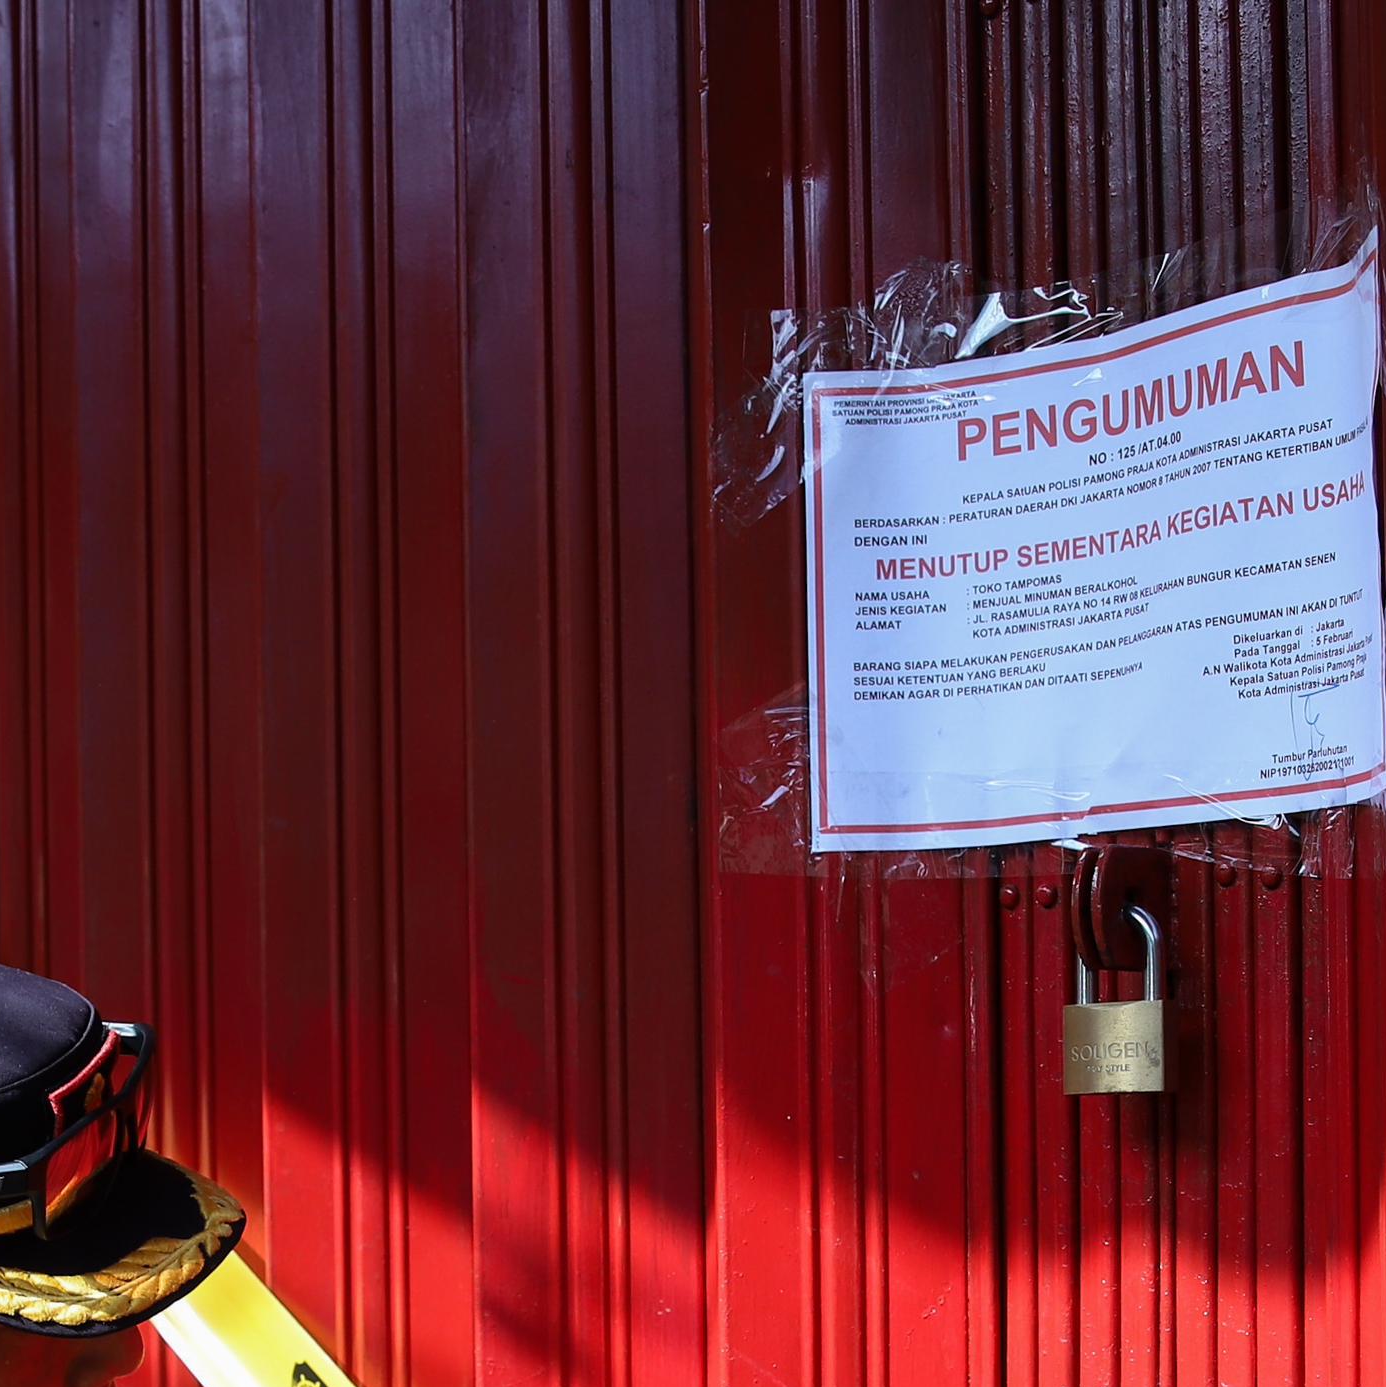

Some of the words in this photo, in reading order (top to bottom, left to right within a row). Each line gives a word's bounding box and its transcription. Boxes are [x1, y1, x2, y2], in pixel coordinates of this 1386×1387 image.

[832, 409, 865, 417] SATUAN
[866, 408, 893, 416] POLISI
[894, 406, 929, 415] PAMONG
[931, 404, 956, 413] PRAJA
[958, 400, 979, 409] KOTA
[833, 400, 886, 408] PEMERINTAH
[887, 398, 925, 407] PROVINSI
[957, 340, 1305, 461] PENGUMUMAN
[844, 417, 902, 426] ADMINISTRASI
[903, 415, 940, 425] JAKARTA
[941, 410, 967, 421] PUSAT
[963, 487, 1004, 504] KEPALA
[1048, 478, 1081, 491] POLISI
[1083, 469, 1125, 486] PAMONG
[1127, 461, 1154, 477] PRAJA
[1155, 453, 1177, 468] KOTA
[1178, 435, 1241, 462] ADMINISTRASI
[1244, 427, 1296, 445] JAKARTA
[1299, 418, 1333, 435] PUSAT
[1089, 452, 1107, 466] NO
[1118, 446, 1136, 460] 125
[1138, 431, 1182, 455] /AT.04.00
[854, 516, 939, 529] BERDASARKAN
[949, 508, 1013, 524] PERATURAN
[1015, 498, 1058, 515] DAERAH
[1061, 496, 1078, 508] DKI
[1080, 487, 1125, 504] JAKARTA
[1126, 478, 1157, 494] NOMOR
[1158, 475, 1163, 486] 8
[1165, 467, 1191, 483] TAHUN
[1192, 461, 1211, 475] 2007
[1214, 451, 1263, 469] TENTANG
[1266, 438, 1333, 460] KETERTIBAN
[1335, 429, 1356, 446] UMUM
[854, 536, 908, 547] DENGAN
[911, 535, 928, 546] INI
[876, 549, 1009, 581] MENUTUP
[1017, 520, 1161, 568] SEMENTARA
[1167, 491, 1294, 538] KEGIATAN
[1303, 470, 1365, 512] USAHA
[855, 592, 888, 601] NAMA
[890, 590, 930, 601] USAHA
[973, 582, 1002, 595] TOKO
[1005, 574, 1062, 590] TAMPOMAS
[855, 620, 902, 631] ALAMAT
[973, 613, 988, 624] JL.
[991, 606, 1050, 622] RASAMULIA
[1053, 601, 1080, 613] RAYA
[1083, 598, 1098, 609] NO
[1101, 596, 1111, 607] 14
[1113, 593, 1128, 605] RW
[1139, 577, 1185, 599] KELURAHAN
[1186, 569, 1232, 586] BUNGUR
[1234, 558, 1303, 579] KECAMATAN
[1304, 551, 1336, 568] SENEN
[855, 606, 887, 616] JENIS
[890, 603, 947, 615] KEGIATAN
[973, 595, 1022, 609] MENJUAL
[1024, 588, 1071, 603] MINUMAN
[1074, 575, 1138, 595] BERALKOHOL
[853, 661, 901, 672] BARANG
[904, 659, 938, 670] SIAPA
[940, 652, 1008, 668] MELAKUKAN
[1010, 642, 1093, 662] PENGERUSAKAN
[1095, 639, 1116, 651] DAN
[1118, 624, 1173, 647] PELANGGARAN
[1175, 618, 1202, 632] ATAS
[1205, 608, 1284, 628] PENGUMUMAN
[1286, 605, 1299, 617] INI
[1301, 599, 1327, 615] AKAN
[1329, 597, 1338, 609] DI
[973, 628, 1002, 639] KOTA
[1004, 616, 1076, 635] ADMINISTRASI
[1078, 608, 1123, 625] JAKARTA
[1124, 602, 1150, 618] PUSAT
[1233, 628, 1292, 645] Dikeluarkan
[1294, 625, 1303, 636] di
[1315, 618, 1345, 633] Jakarta
[1234, 646, 1260, 659] Pada
[1263, 640, 1301, 656] Tanggal
[1316, 636, 1321, 647] 5
[1323, 628, 1354, 645] Februari
[853, 676, 894, 686] SESUAI
[898, 672, 964, 685] KETENTUAN
[966, 669, 996, 681] YANG
[999, 662, 1046, 678] BERLAKU
[1202, 664, 1221, 676] A.N
[1223, 659, 1268, 674] Walikota
[1270, 656, 1292, 668] Kota
[1294, 646, 1345, 665] Administrasi
[1230, 671, 1264, 687] Kepala
[1267, 668, 1299, 682] Satuan
[1301, 663, 1325, 677] Polisi
[1327, 656, 1355, 673] Pamong
[854, 691, 905, 701] DEMIKAN
[907, 688, 940, 700] AGAR
[943, 687, 953, 697] DI
[957, 680, 1022, 696] PERHATIKAN
[1025, 677, 1045, 689] DAN
[1047, 672, 1088, 686] DITAATI
[1090, 661, 1143, 682] SEPENUHNYA
[1238, 688, 1262, 700] Kota
[1264, 678, 1320, 697] Administrasi
[1321, 674, 1349, 686] Jakarta
[1272, 751, 1306, 764] Tumbur
[1071, 1041, 1149, 1062] SOLIGEN
